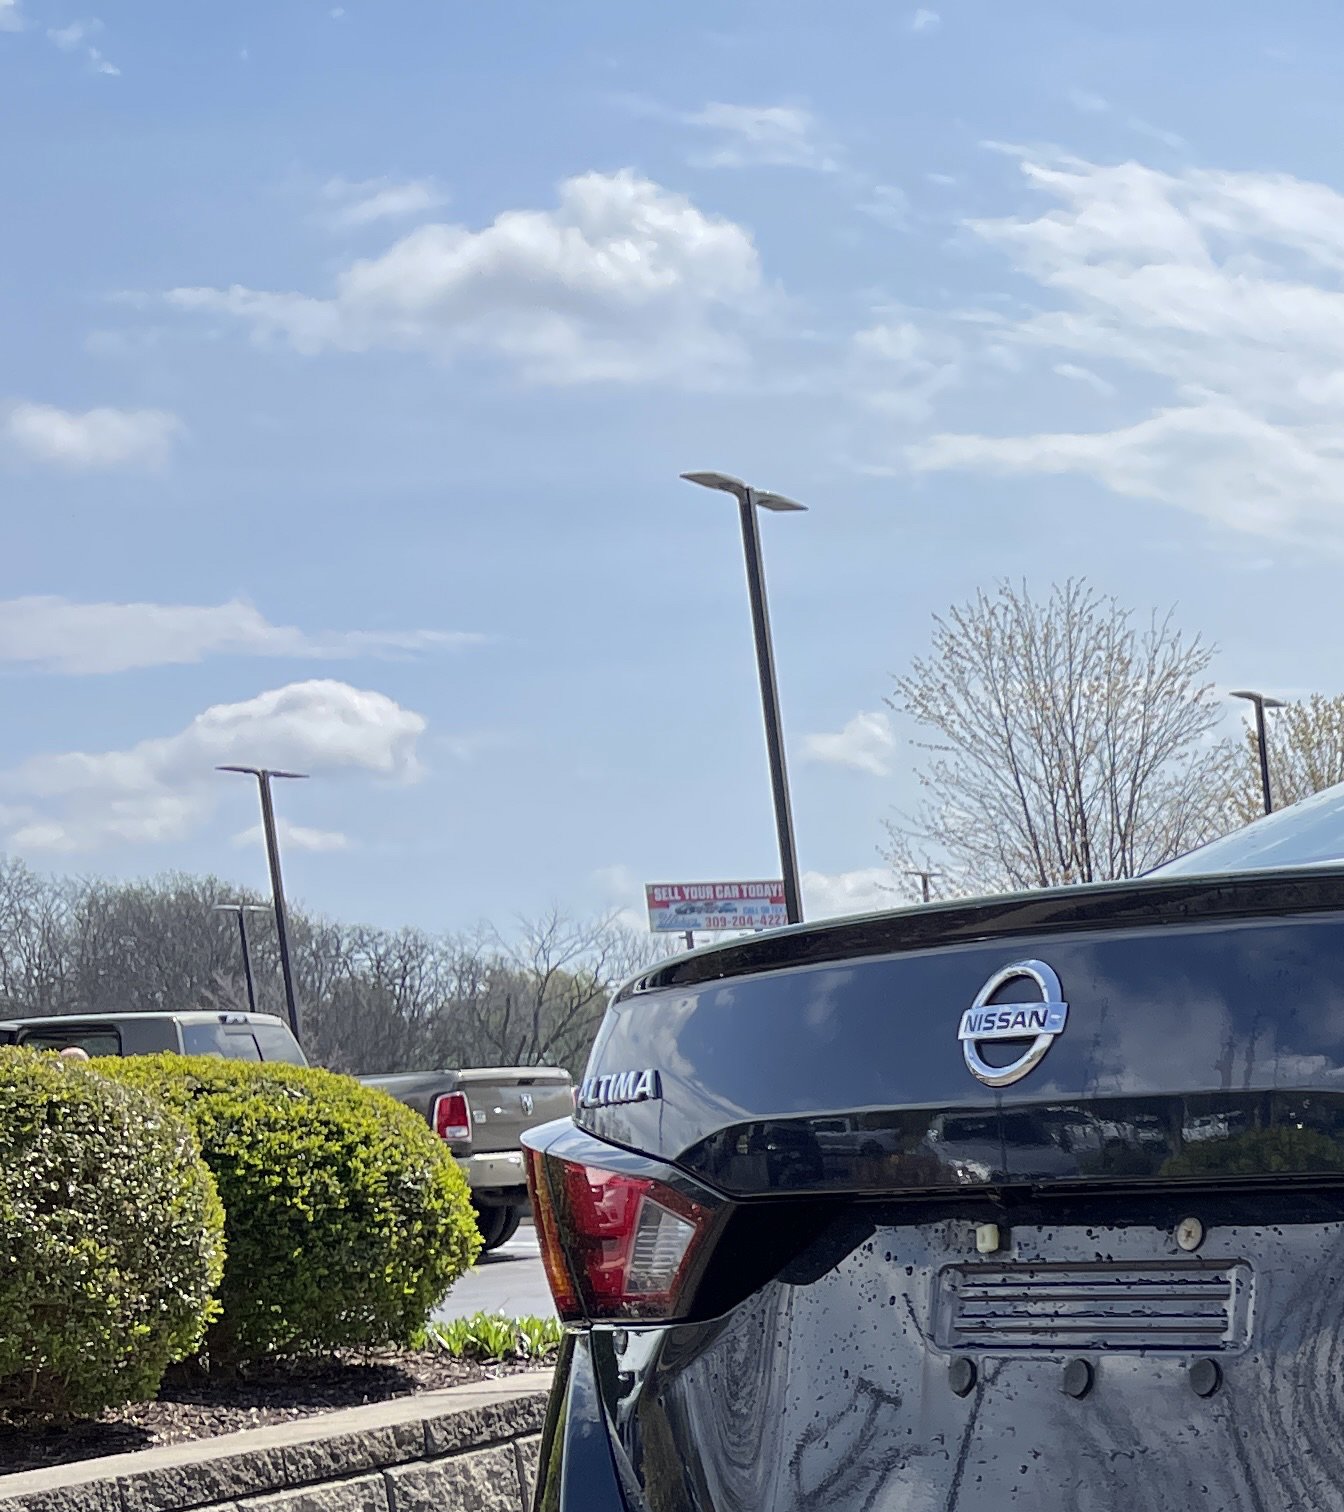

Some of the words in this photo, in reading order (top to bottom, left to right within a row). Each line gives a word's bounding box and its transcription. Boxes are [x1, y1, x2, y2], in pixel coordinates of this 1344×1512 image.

[654, 886, 681, 901] SELL
[683, 885, 714, 900] YOUR
[715, 884, 738, 899] CAR
[740, 882, 783, 898] TODAY!
[964, 1010, 1048, 1032] NISSAN
